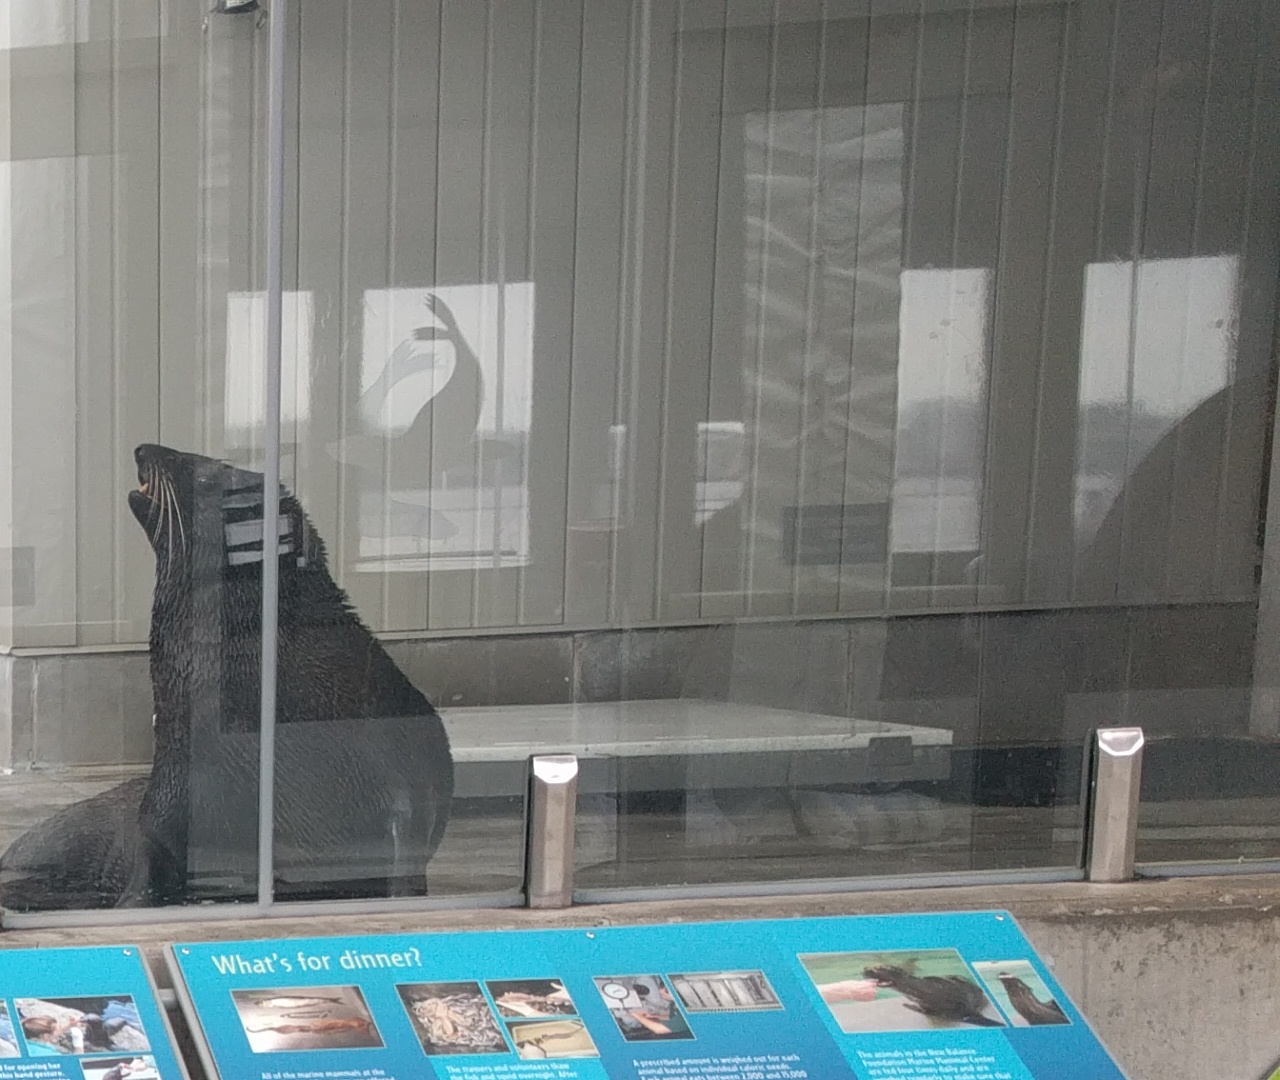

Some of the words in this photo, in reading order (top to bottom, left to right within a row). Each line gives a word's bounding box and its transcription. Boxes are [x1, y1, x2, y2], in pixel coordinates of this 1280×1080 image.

[212, 952, 291, 975] What's
[297, 952, 330, 972] for
[339, 948, 421, 971] dinner?
